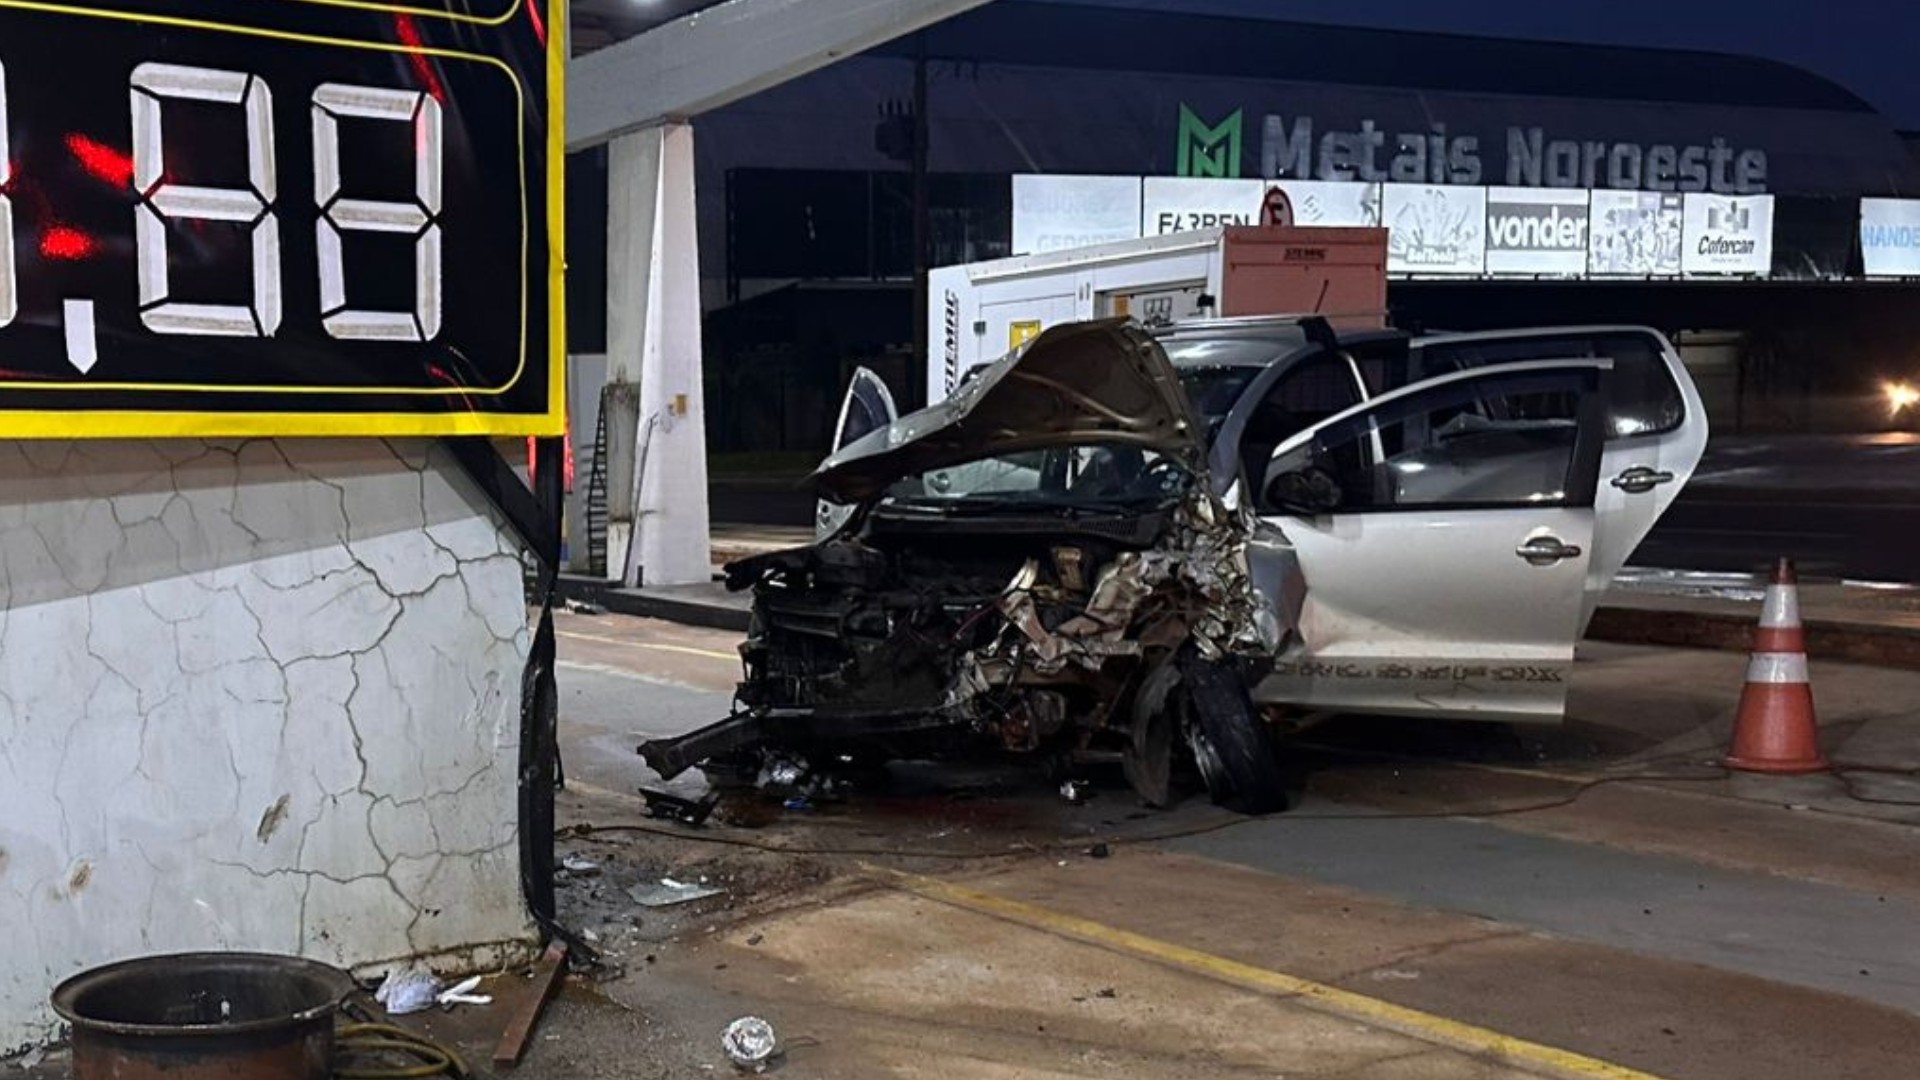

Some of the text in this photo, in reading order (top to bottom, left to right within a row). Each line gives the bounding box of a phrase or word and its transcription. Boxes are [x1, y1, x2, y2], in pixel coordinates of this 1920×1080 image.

[1262, 114, 1767, 193] Metais Noroeste
[1698, 235, 1755, 255] Cofercan
